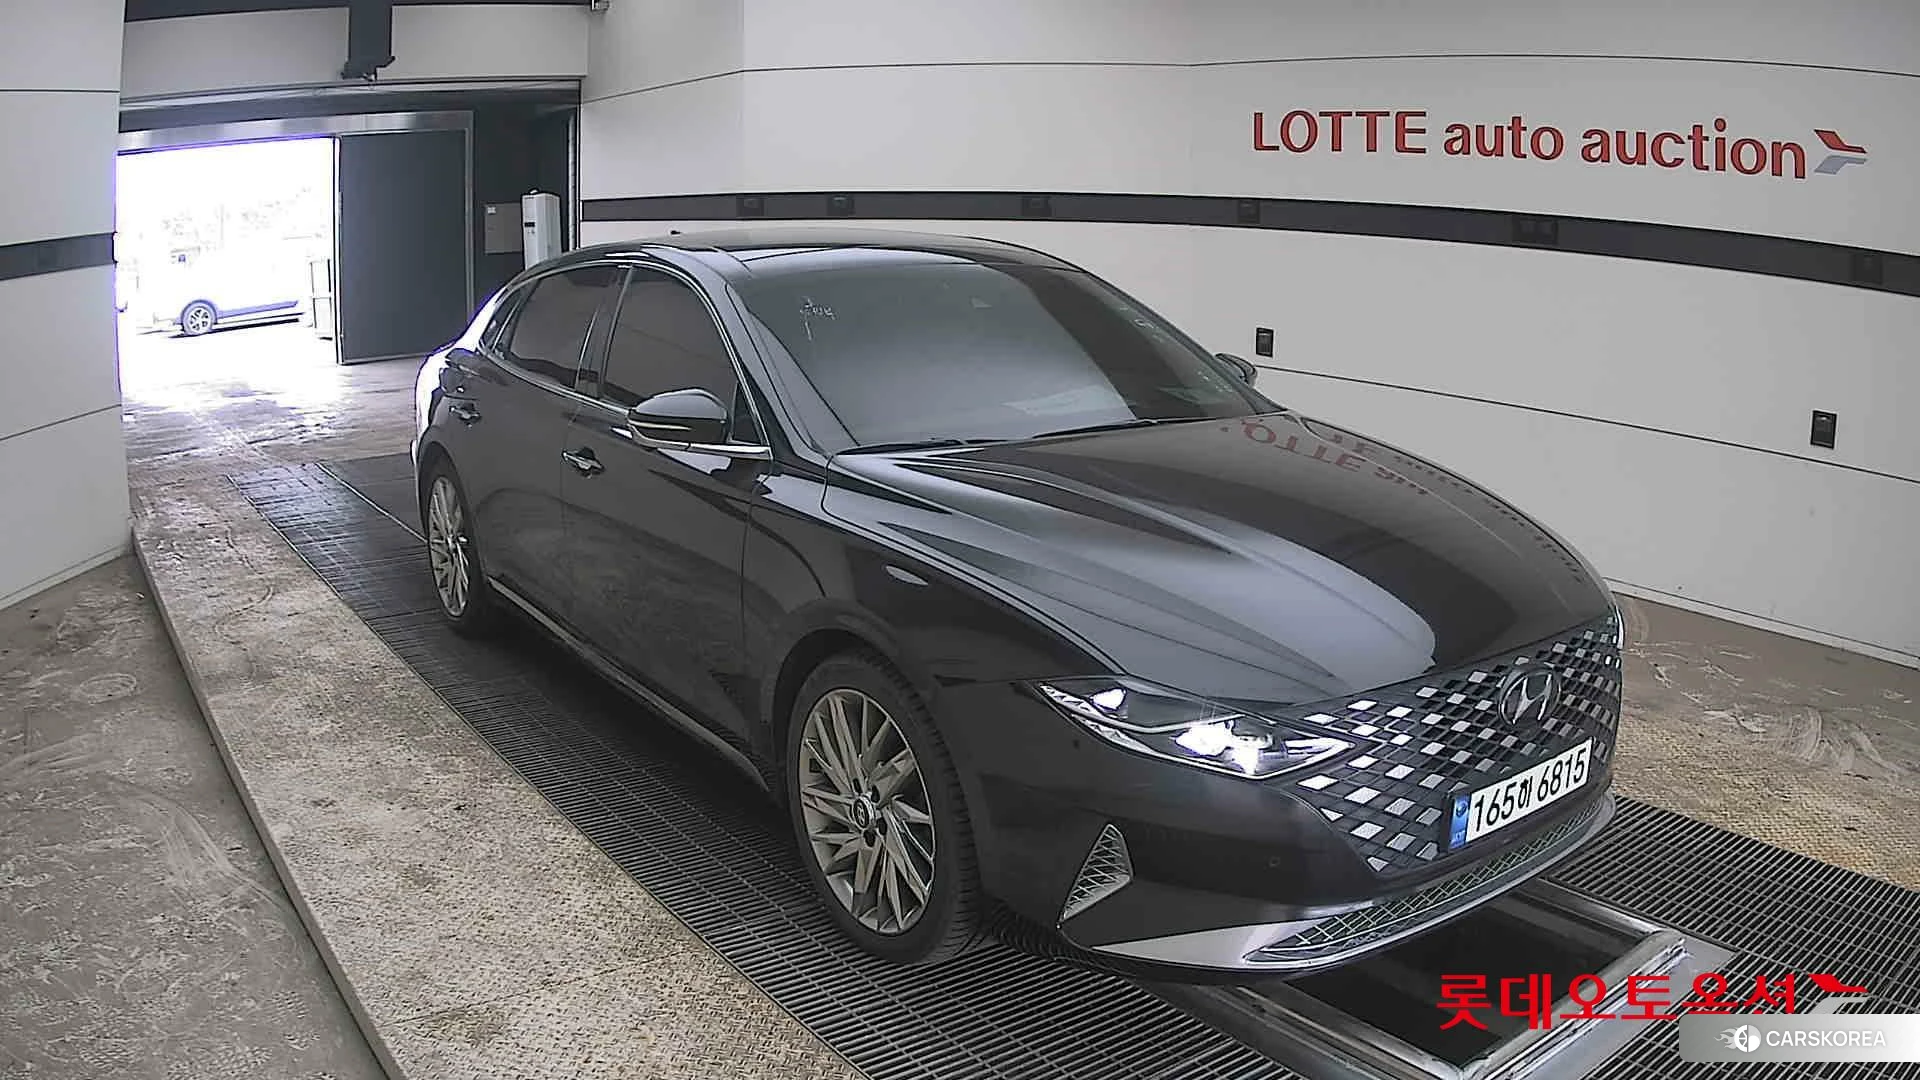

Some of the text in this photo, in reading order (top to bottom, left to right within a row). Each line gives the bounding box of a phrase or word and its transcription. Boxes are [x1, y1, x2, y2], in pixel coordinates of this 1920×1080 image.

[1253, 110, 1806, 180] LOTTE auto auction
[1537, 748, 1587, 802] 6815
